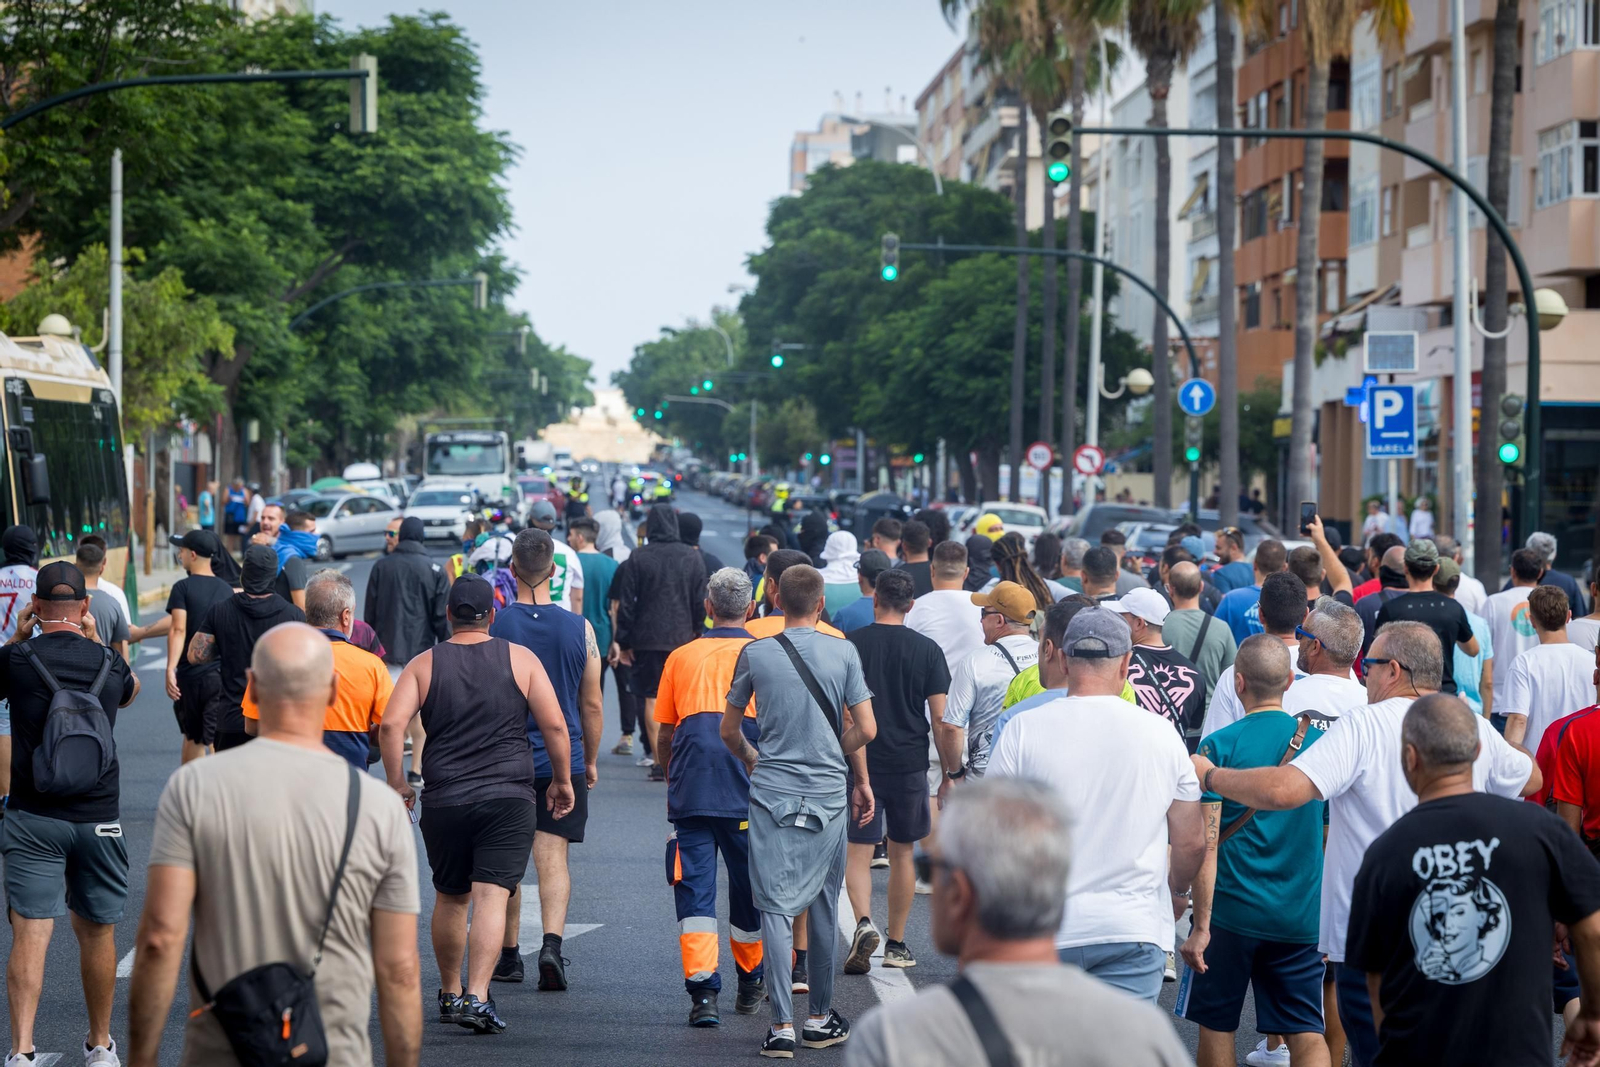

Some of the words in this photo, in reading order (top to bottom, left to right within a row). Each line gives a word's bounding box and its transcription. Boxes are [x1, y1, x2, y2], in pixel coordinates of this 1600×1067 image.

[1375, 390, 1404, 429] P
[0, 592, 18, 631] 7
[1412, 837, 1500, 880] OBEY
